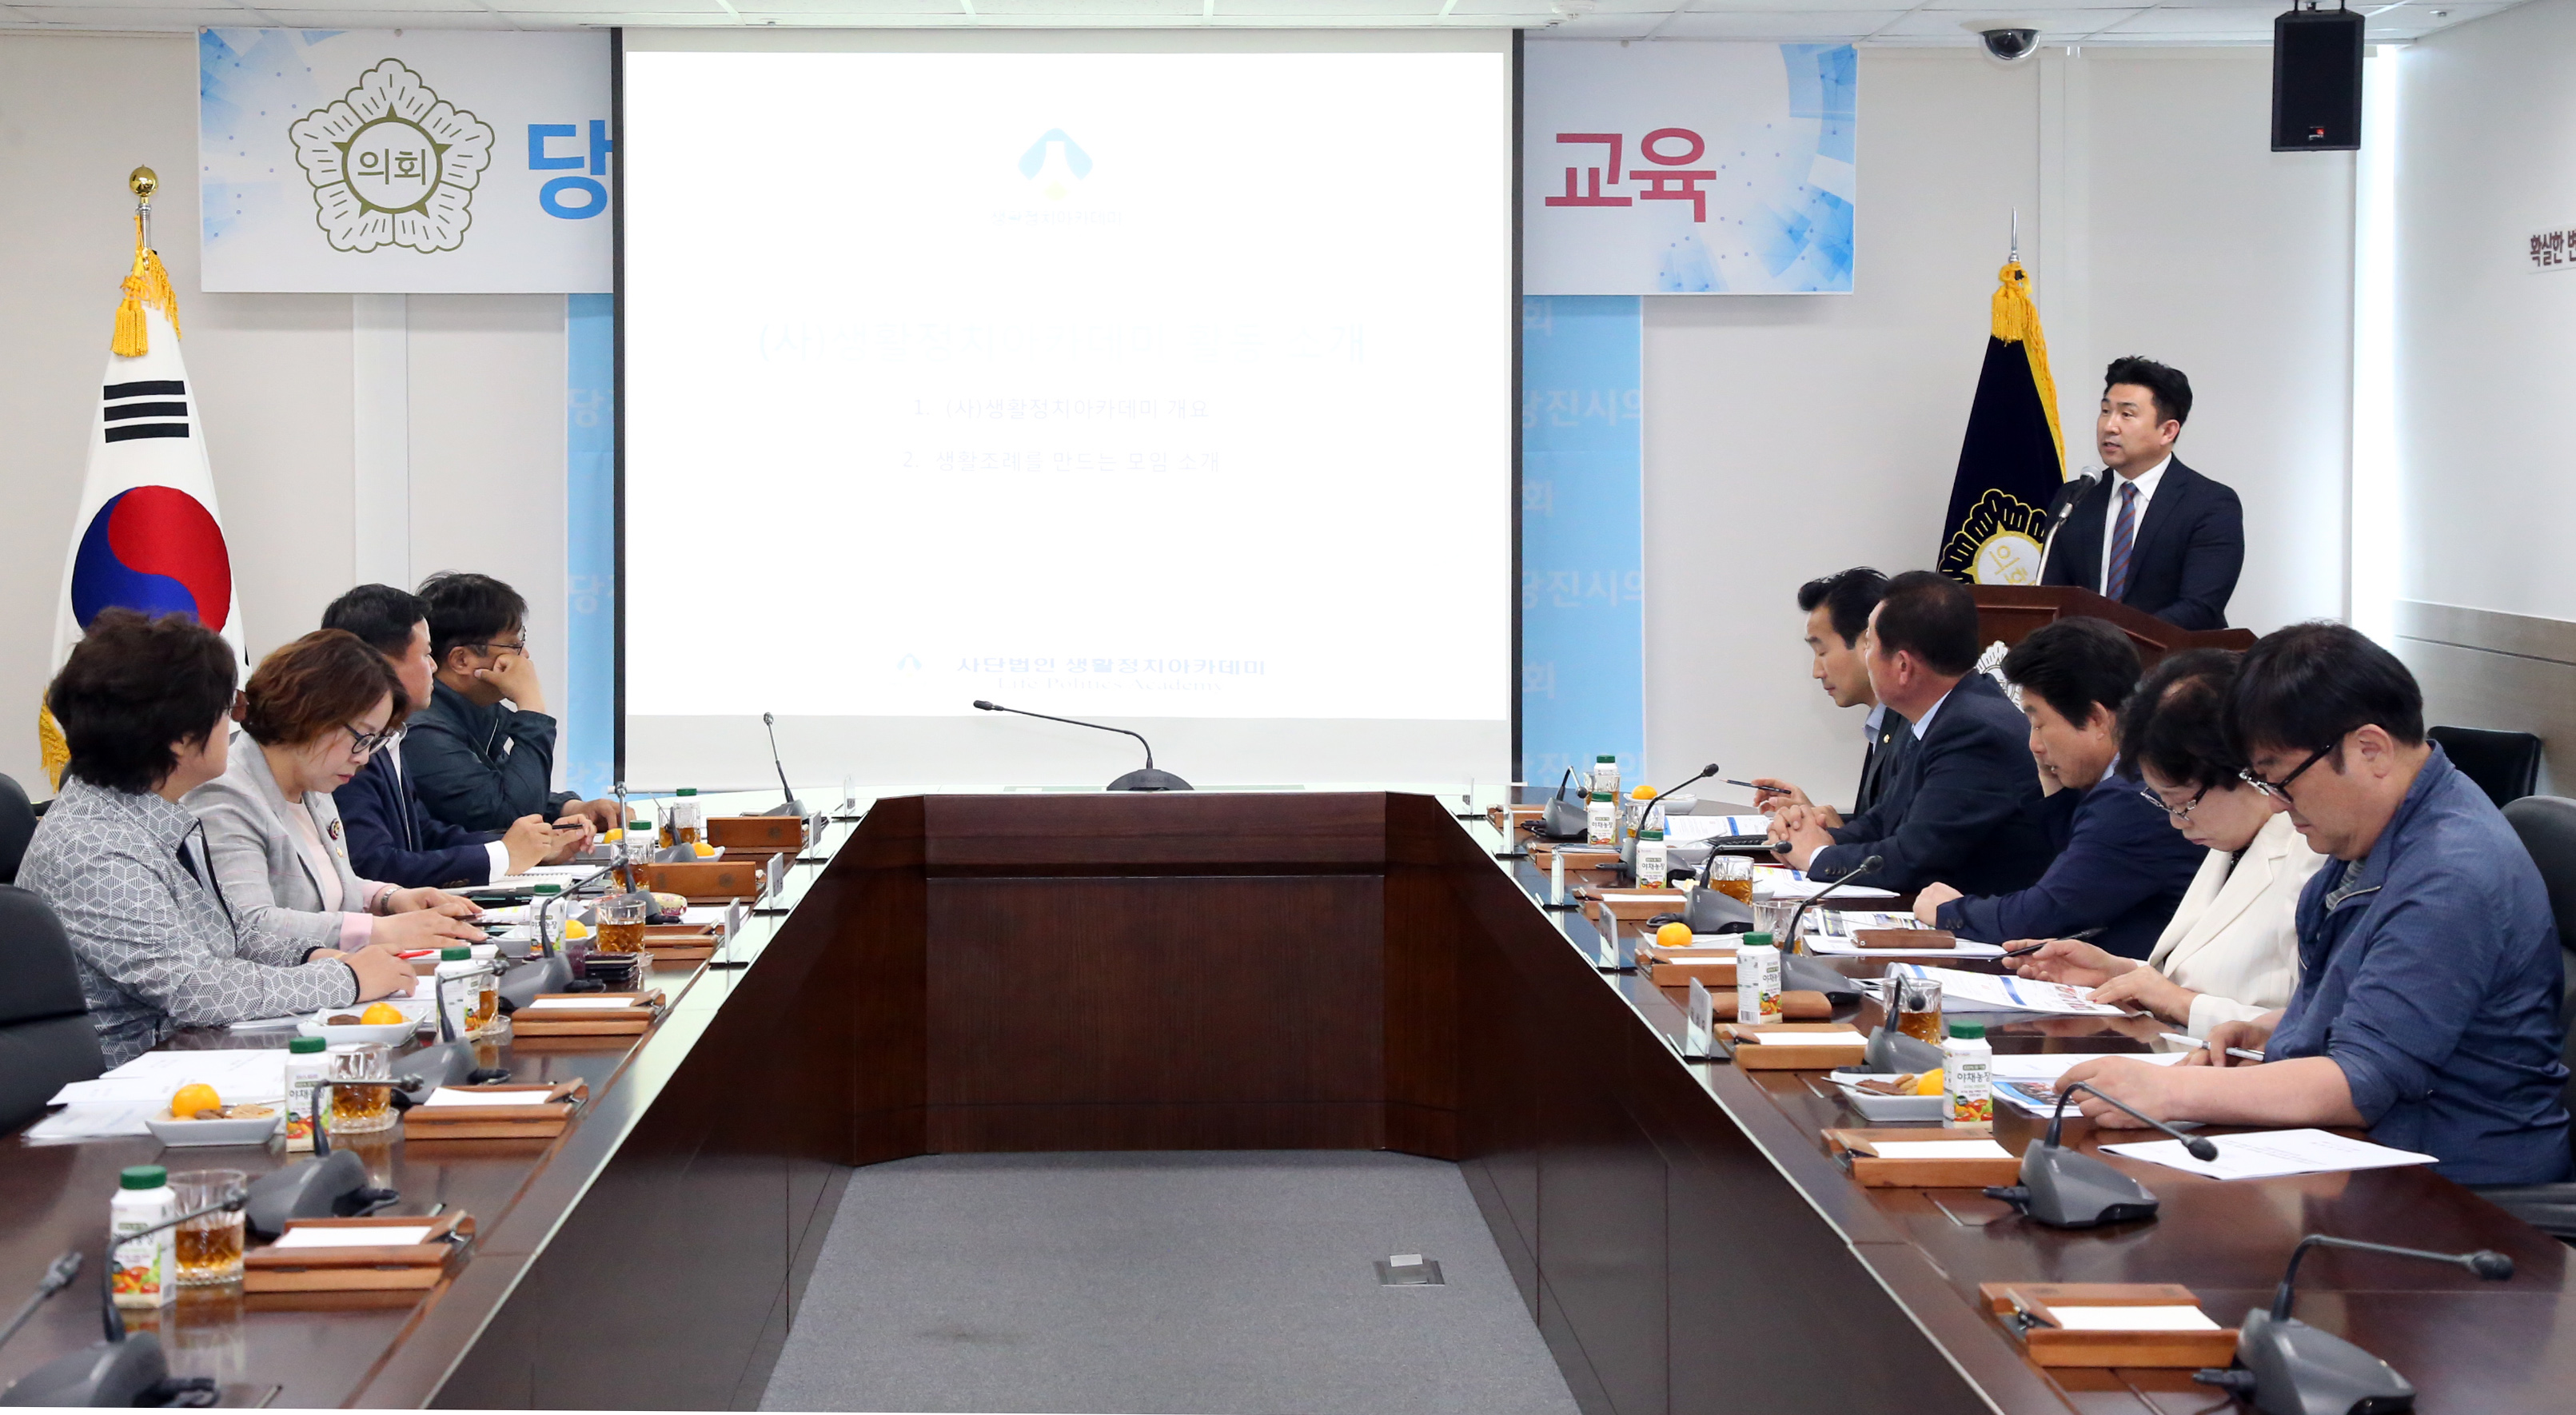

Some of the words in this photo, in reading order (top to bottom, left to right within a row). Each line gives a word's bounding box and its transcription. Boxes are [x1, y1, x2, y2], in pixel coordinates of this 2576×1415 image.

[357, 148, 427, 185] 의회
[1545, 127, 1717, 223] 교육
[2530, 232, 2564, 267] 확실한
[759, 321, 1162, 363] (사)생활정치아카데미
[1186, 321, 1266, 363] 활동
[1286, 322, 1364, 364] 소개
[947, 398, 1158, 420] (사)생활정치아카데미
[1168, 399, 1210, 420] 개요
[936, 450, 1043, 472] 생활조례를
[1053, 452, 1117, 472] 만드는
[1127, 452, 1167, 472] 모임
[1178, 452, 1219, 472] 소개
[956, 657, 1055, 673] 사단법인
[1066, 657, 1266, 676] 생활정치아카데미
[999, 677, 1038, 690] Life
[1047, 677, 1123, 691] Politics
[1131, 678, 1223, 694] Academy
[1956, 1071, 1991, 1083] 야채농장
